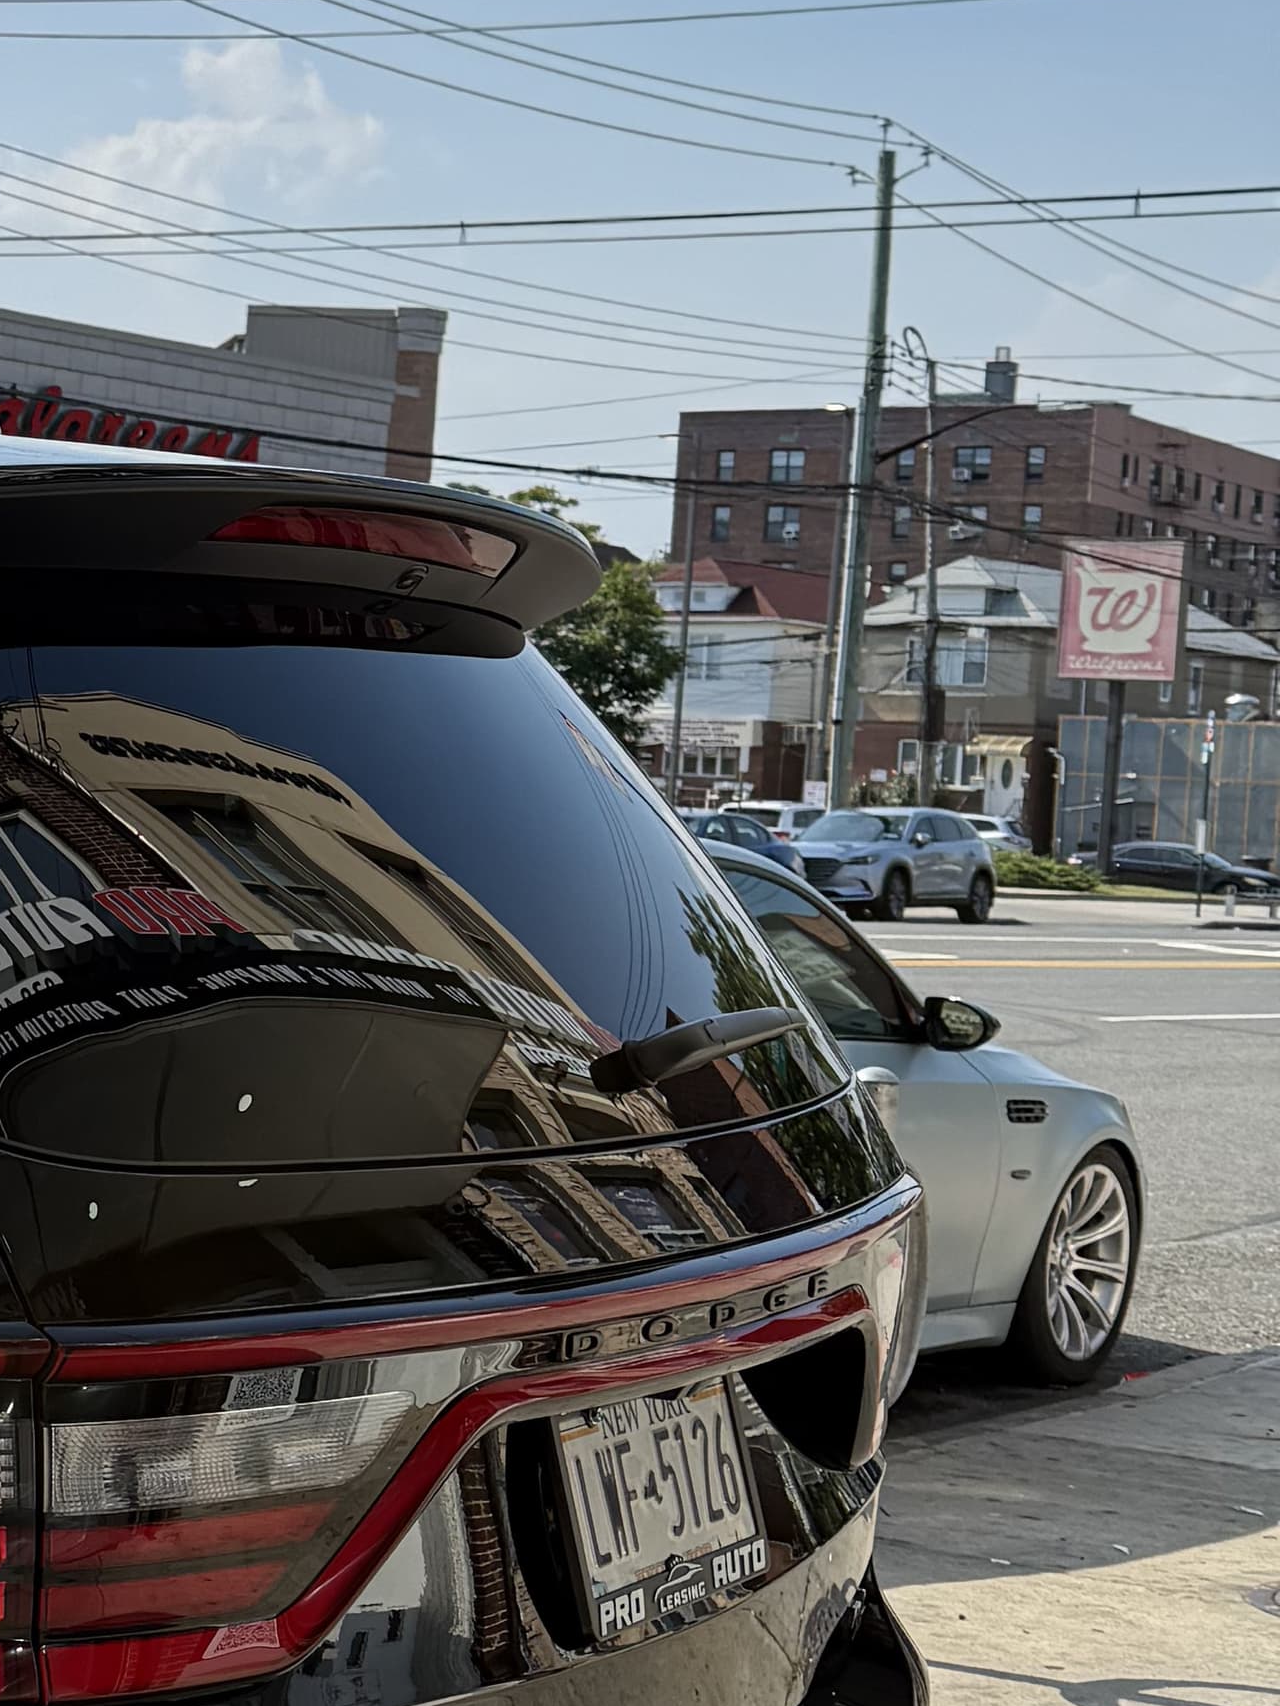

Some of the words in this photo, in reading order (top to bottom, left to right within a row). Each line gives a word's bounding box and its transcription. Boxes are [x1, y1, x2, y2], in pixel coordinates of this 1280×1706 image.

[1087, 583, 1157, 631] W
[1066, 654, 1166, 675] Walgreens
[564, 1271, 829, 1362] DODGE
[600, 1400, 641, 1440] NEW
[643, 1395, 691, 1427] YORK
[599, 1587, 645, 1638] PRO
[711, 1538, 767, 1590] AUTO
[658, 1580, 707, 1614] LEASING
